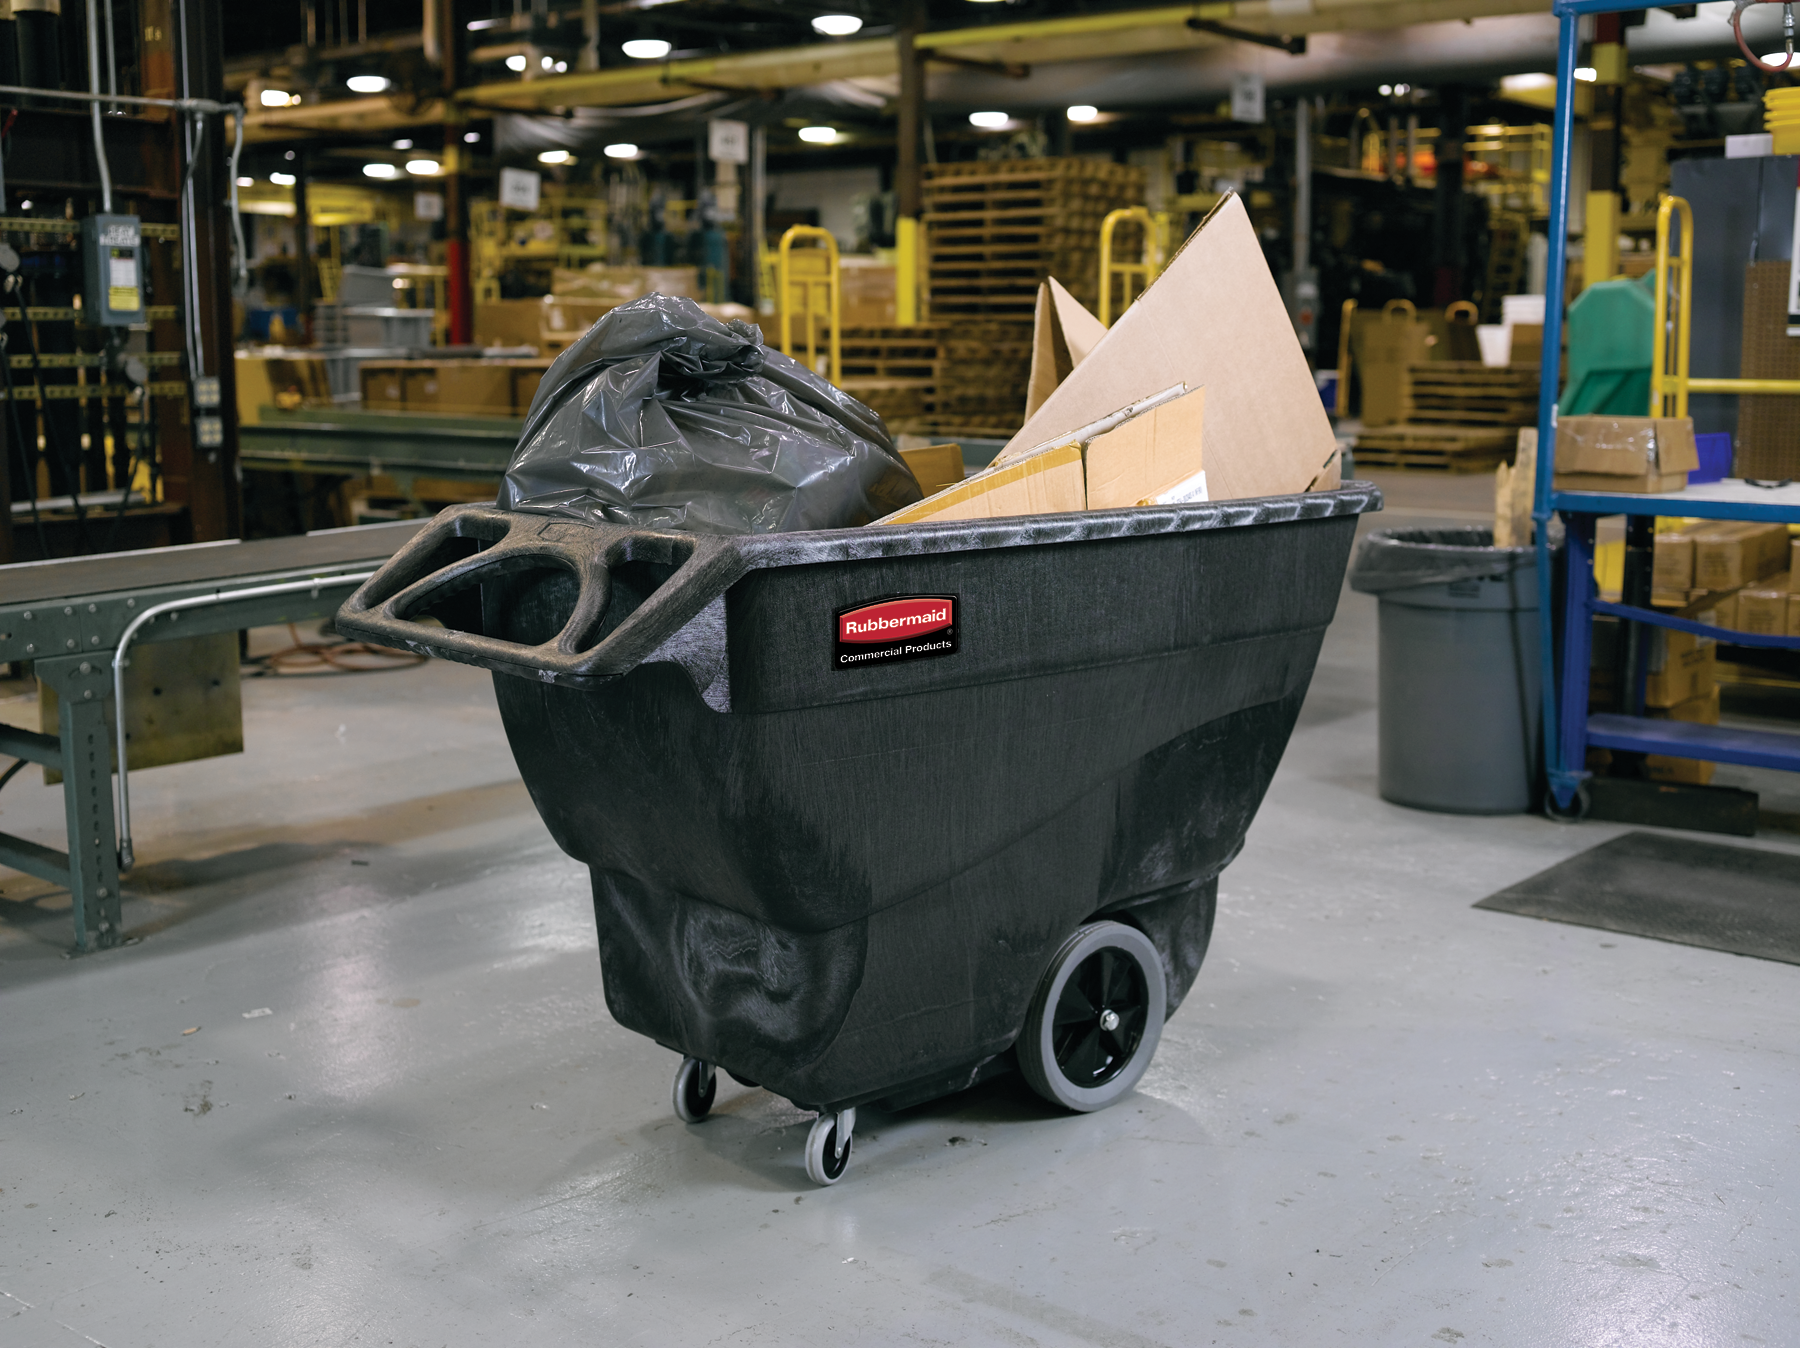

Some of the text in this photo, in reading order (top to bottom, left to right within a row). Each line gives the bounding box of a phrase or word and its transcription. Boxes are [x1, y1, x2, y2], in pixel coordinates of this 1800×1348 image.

[845, 608, 947, 635] Rubbermaid
[840, 640, 952, 663] Commercial Products
